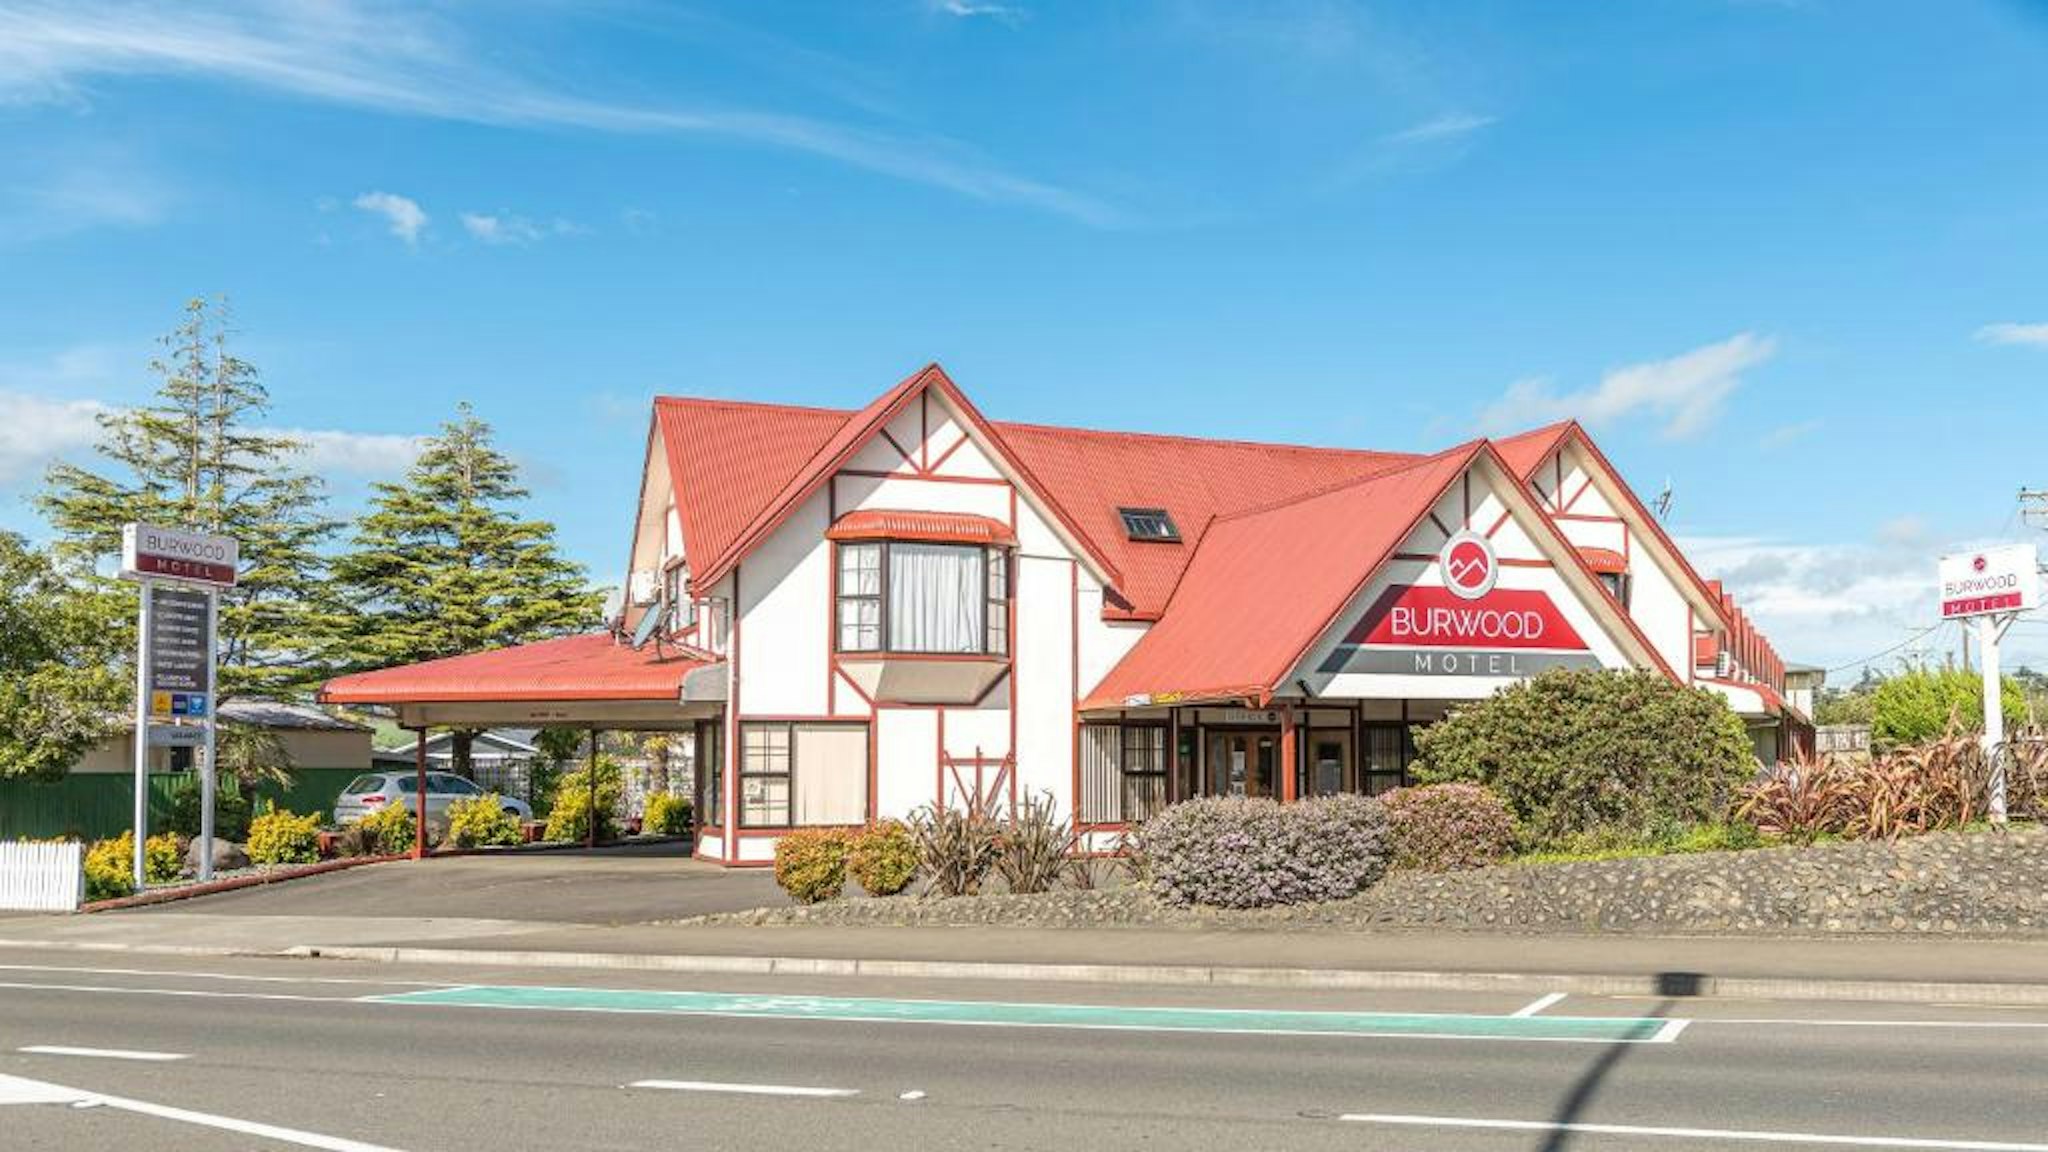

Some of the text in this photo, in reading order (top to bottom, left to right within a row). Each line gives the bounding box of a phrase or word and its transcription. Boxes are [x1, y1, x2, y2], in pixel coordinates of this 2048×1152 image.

[148, 535, 225, 561] BURWOOD
[156, 560, 213, 578] MOTEL
[1945, 573, 2017, 597] BURWOOD
[1951, 597, 2016, 614] MOTEL
[1391, 607, 1544, 639] BURWOOD
[1415, 653, 1523, 674] MOTEL
